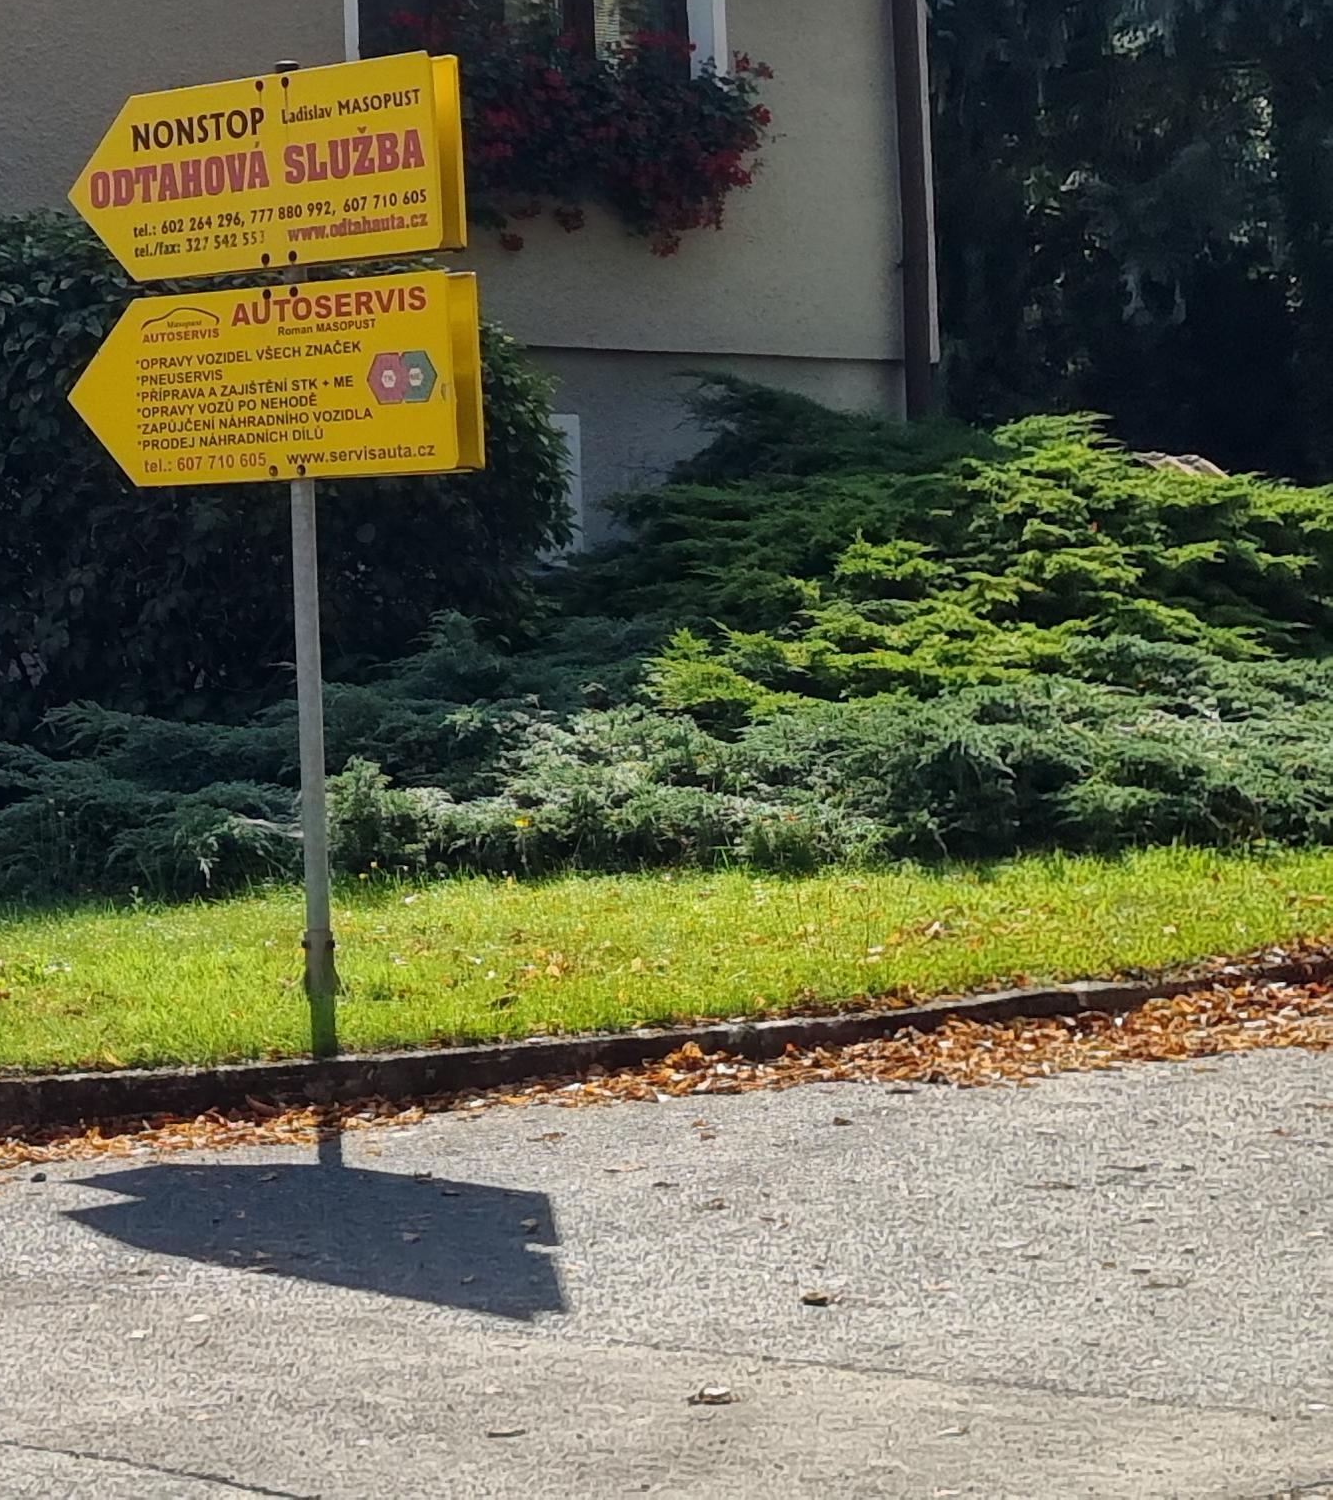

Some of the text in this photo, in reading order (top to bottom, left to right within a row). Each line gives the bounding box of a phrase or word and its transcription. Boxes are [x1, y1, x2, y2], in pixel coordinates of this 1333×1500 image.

[131, 88, 420, 152] NONSTOP Ladislav MASOPUST
[90, 126, 425, 209] ODTAHOVÁ SLUŽBA
[133, 189, 427, 238] tel.: 602 264 296, 777 880 992, 607 710 605
[134, 241, 181, 258] tel./fax:
[186, 236, 209, 253] 327
[214, 233, 237, 249] 542
[288, 213, 428, 242] www.odtahauta.cz
[231, 286, 427, 327] AUTOSERVIS
[142, 328, 220, 343] AUTOSERVIS
[278, 318, 376, 336] Roman MASOPUST
[197, 351, 252, 365] VOZIDEL
[256, 346, 301, 361] VŠECH
[305, 340, 362, 357] ZNAČEK
[208, 387, 218, 397] A
[221, 378, 287, 397] ZAJIŠTĚNÍ
[292, 379, 318, 392] STK
[333, 375, 354, 388] ME
[198, 401, 234, 415] VOZŮ
[238, 399, 257, 411] PO
[261, 392, 317, 409] NEHODĚ
[219, 412, 309, 429] NÁHRADNÍHO
[313, 407, 373, 423] VOZIDLA
[199, 430, 288, 447] NÁHRADNÍCH
[292, 425, 324, 441] DÍLŮ
[144, 444, 435, 473] tel.: 607 710 605 www.servisauta.cz
